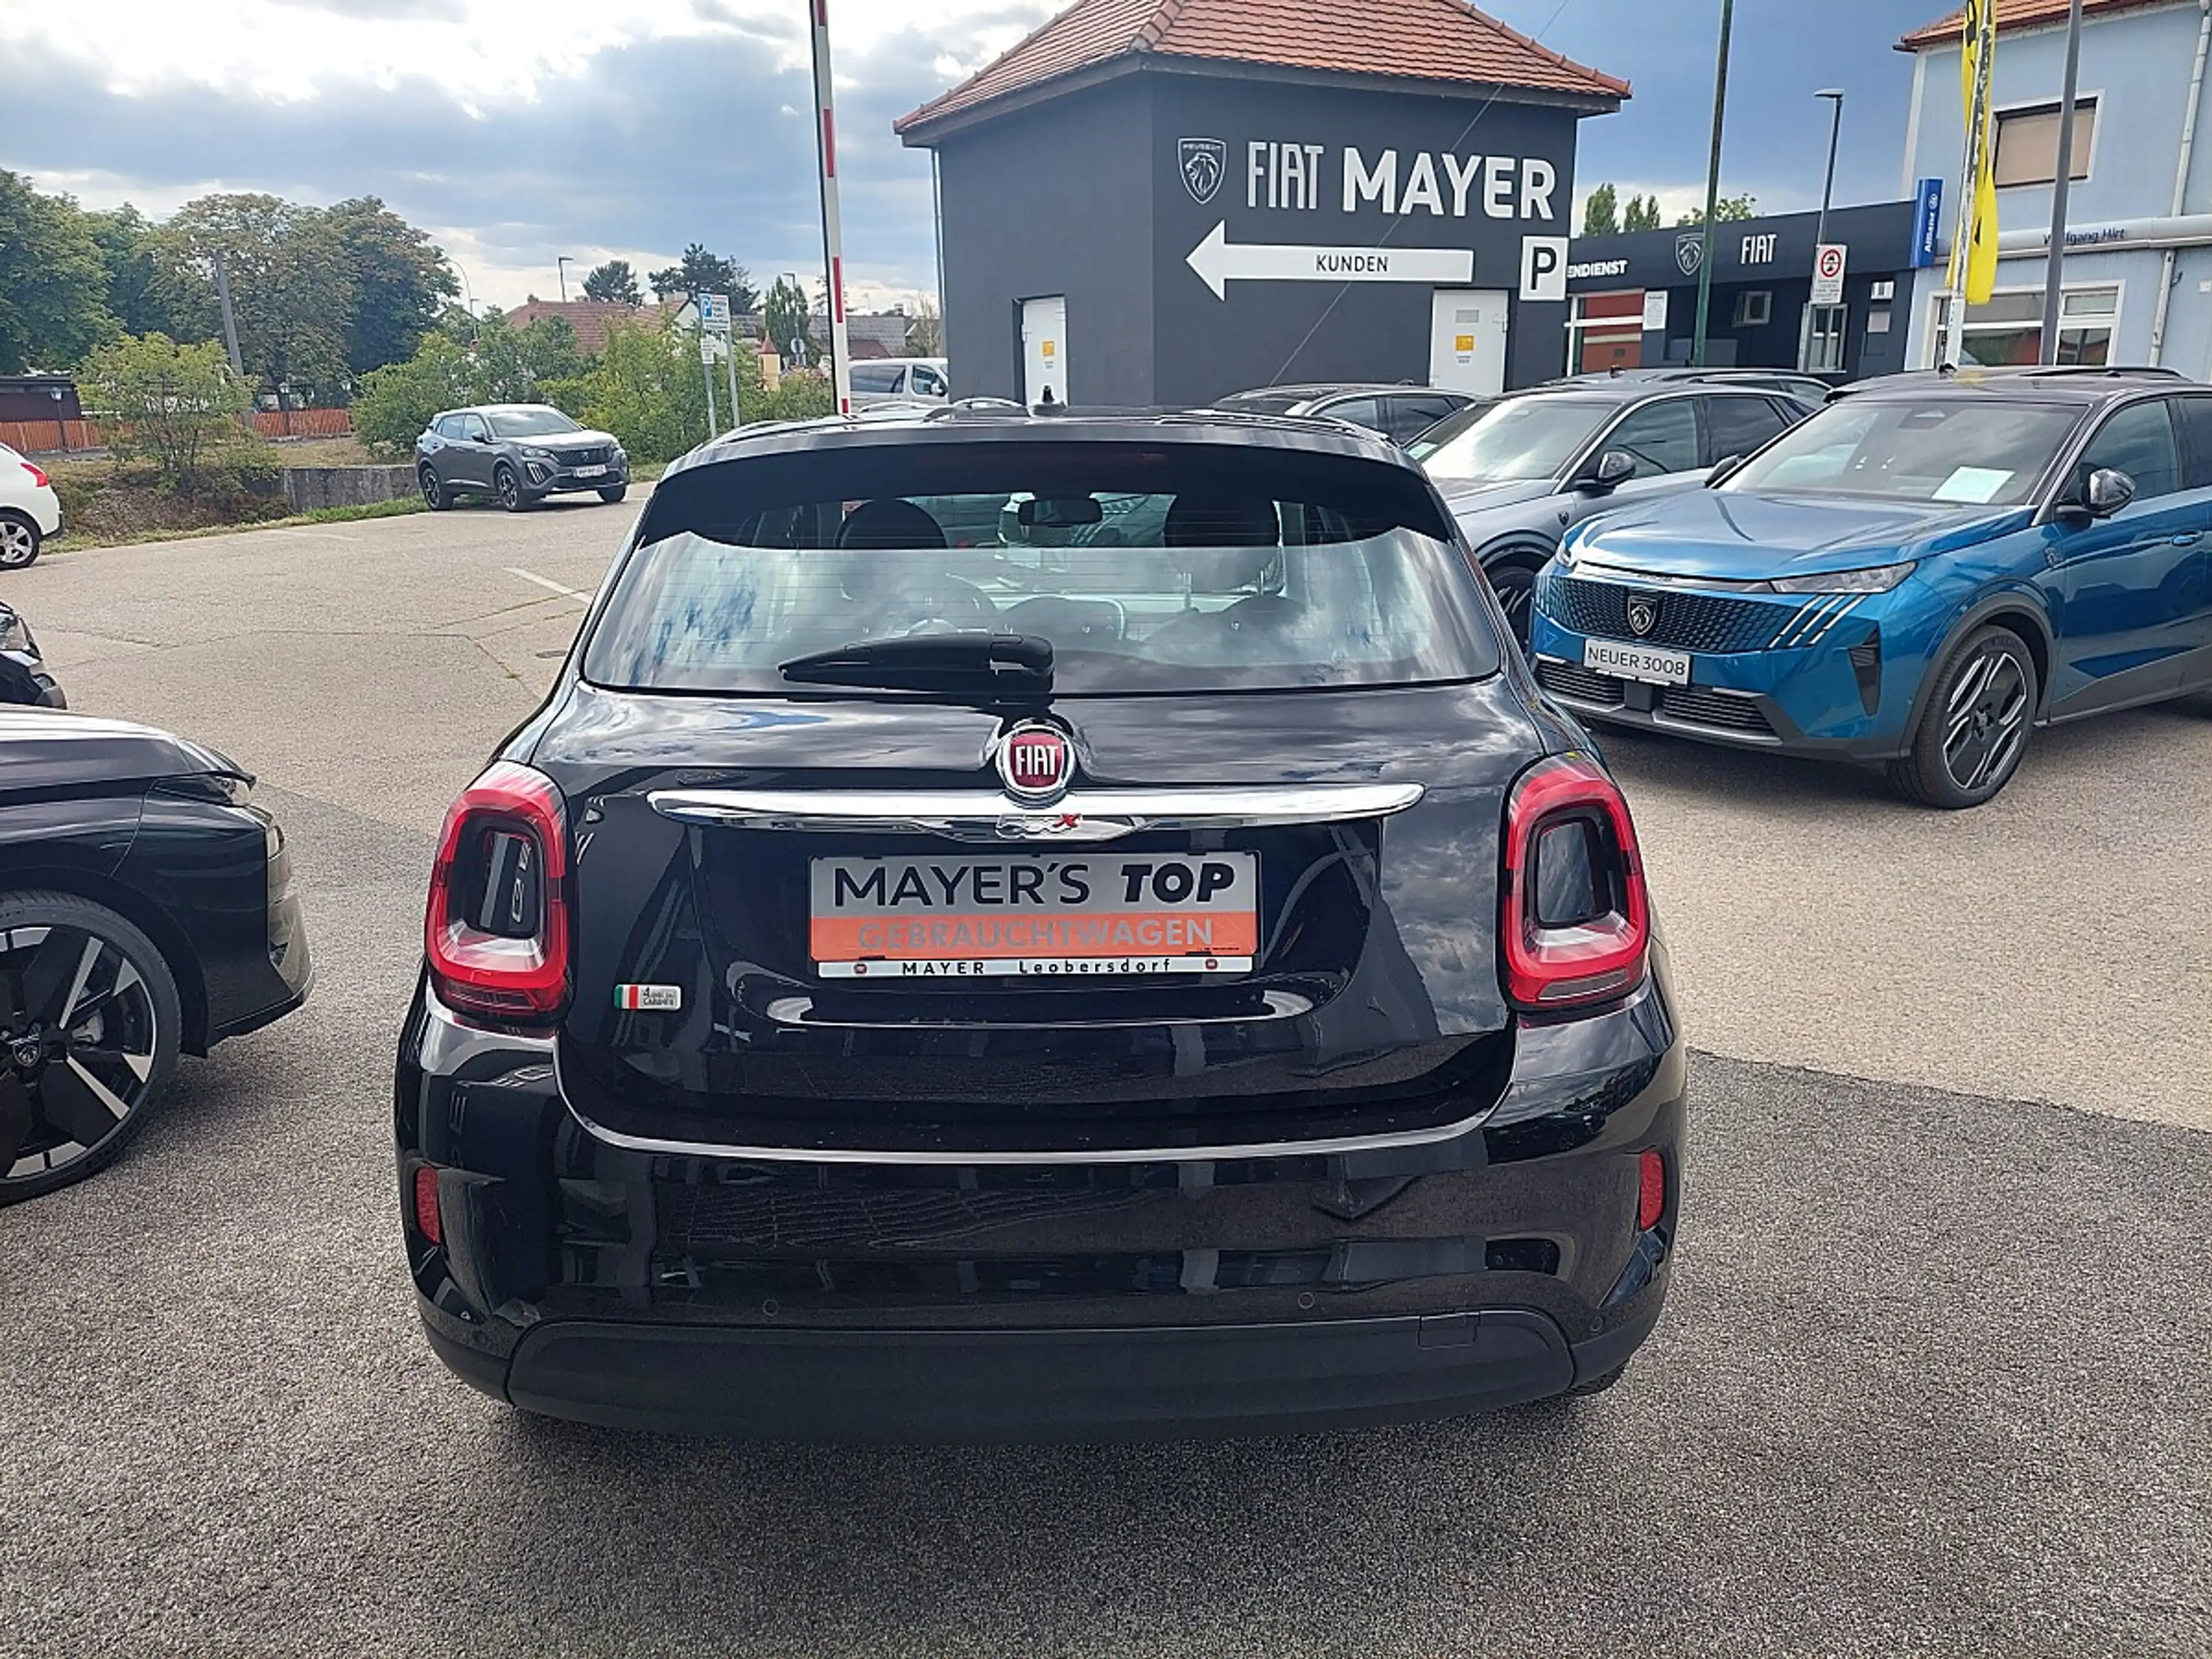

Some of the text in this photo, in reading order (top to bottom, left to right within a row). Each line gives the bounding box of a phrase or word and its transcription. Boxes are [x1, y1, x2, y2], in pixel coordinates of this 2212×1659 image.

[1248, 142, 1555, 220] FIAT MAYER
[1316, 254, 1388, 272] KUNDEN
[1740, 234, 1778, 265] FIAT
[1531, 247, 1556, 290] P
[1588, 646, 1686, 676] NEUER 3008
[1015, 745, 1059, 776] FIAT
[1120, 862, 1234, 903] TOP
[858, 919, 1213, 949] GEBRAUCHTWAGEN
[902, 957, 1171, 975] MAYER Leobersdorf
